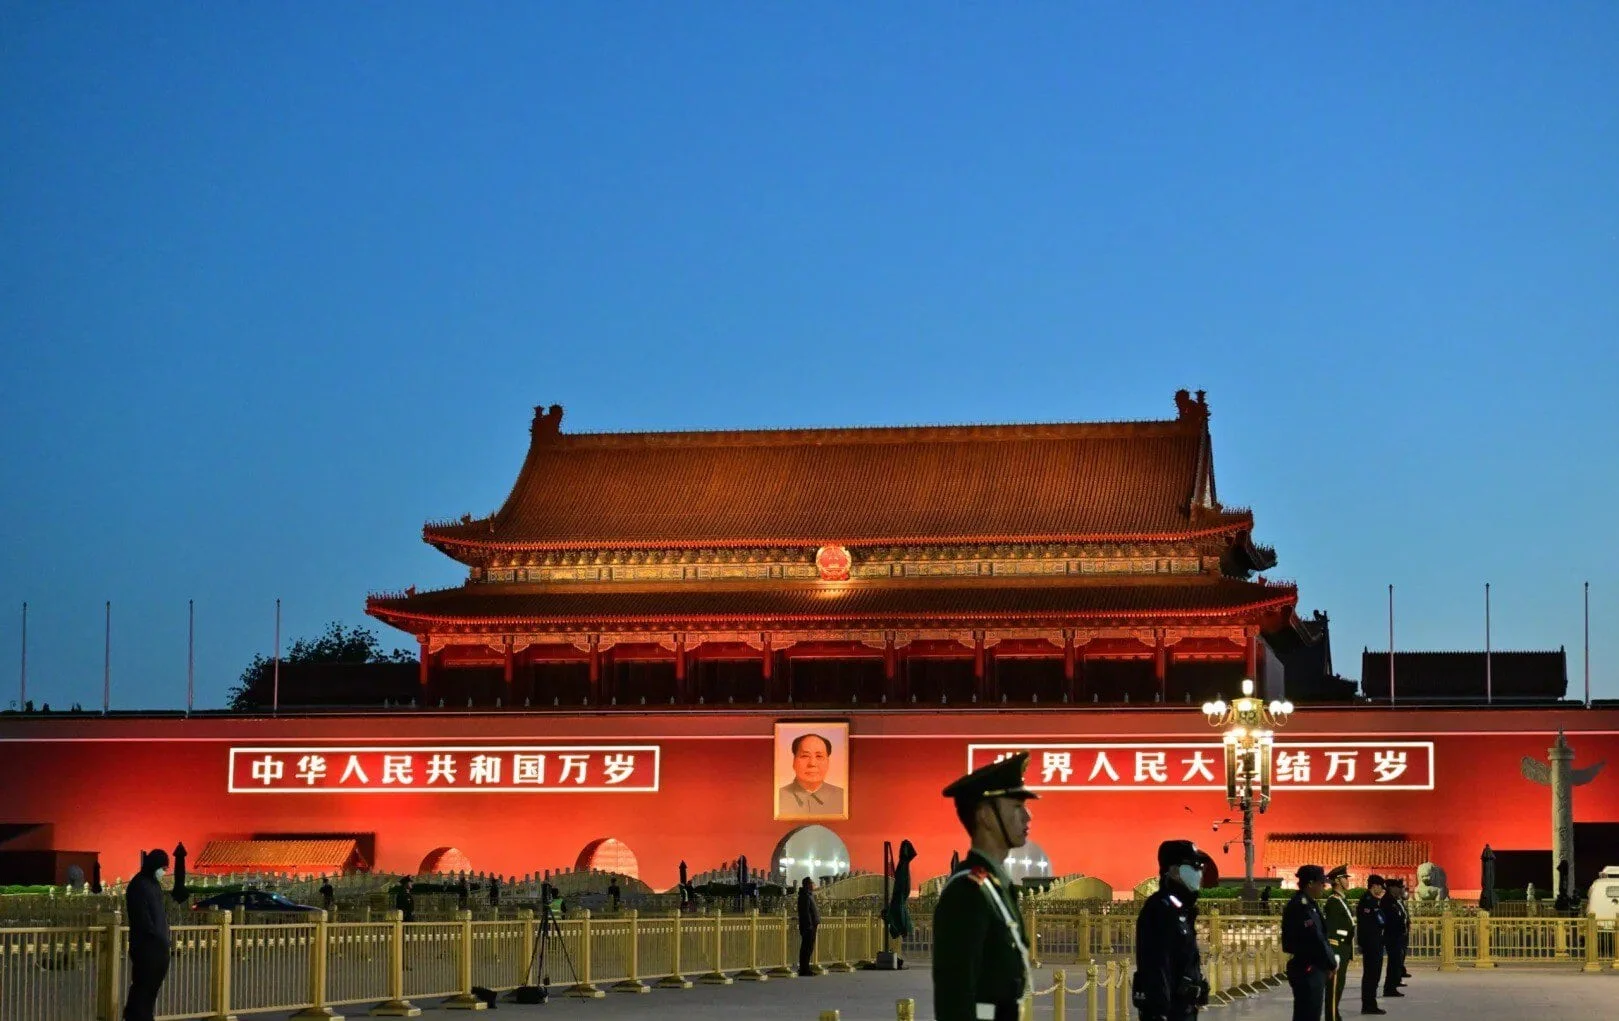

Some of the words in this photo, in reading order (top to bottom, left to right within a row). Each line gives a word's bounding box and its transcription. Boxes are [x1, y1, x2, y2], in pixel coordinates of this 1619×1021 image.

[251, 753, 635, 785] 中华人民共和国万岁
[993, 750, 1408, 783] 界人民大结万岁
